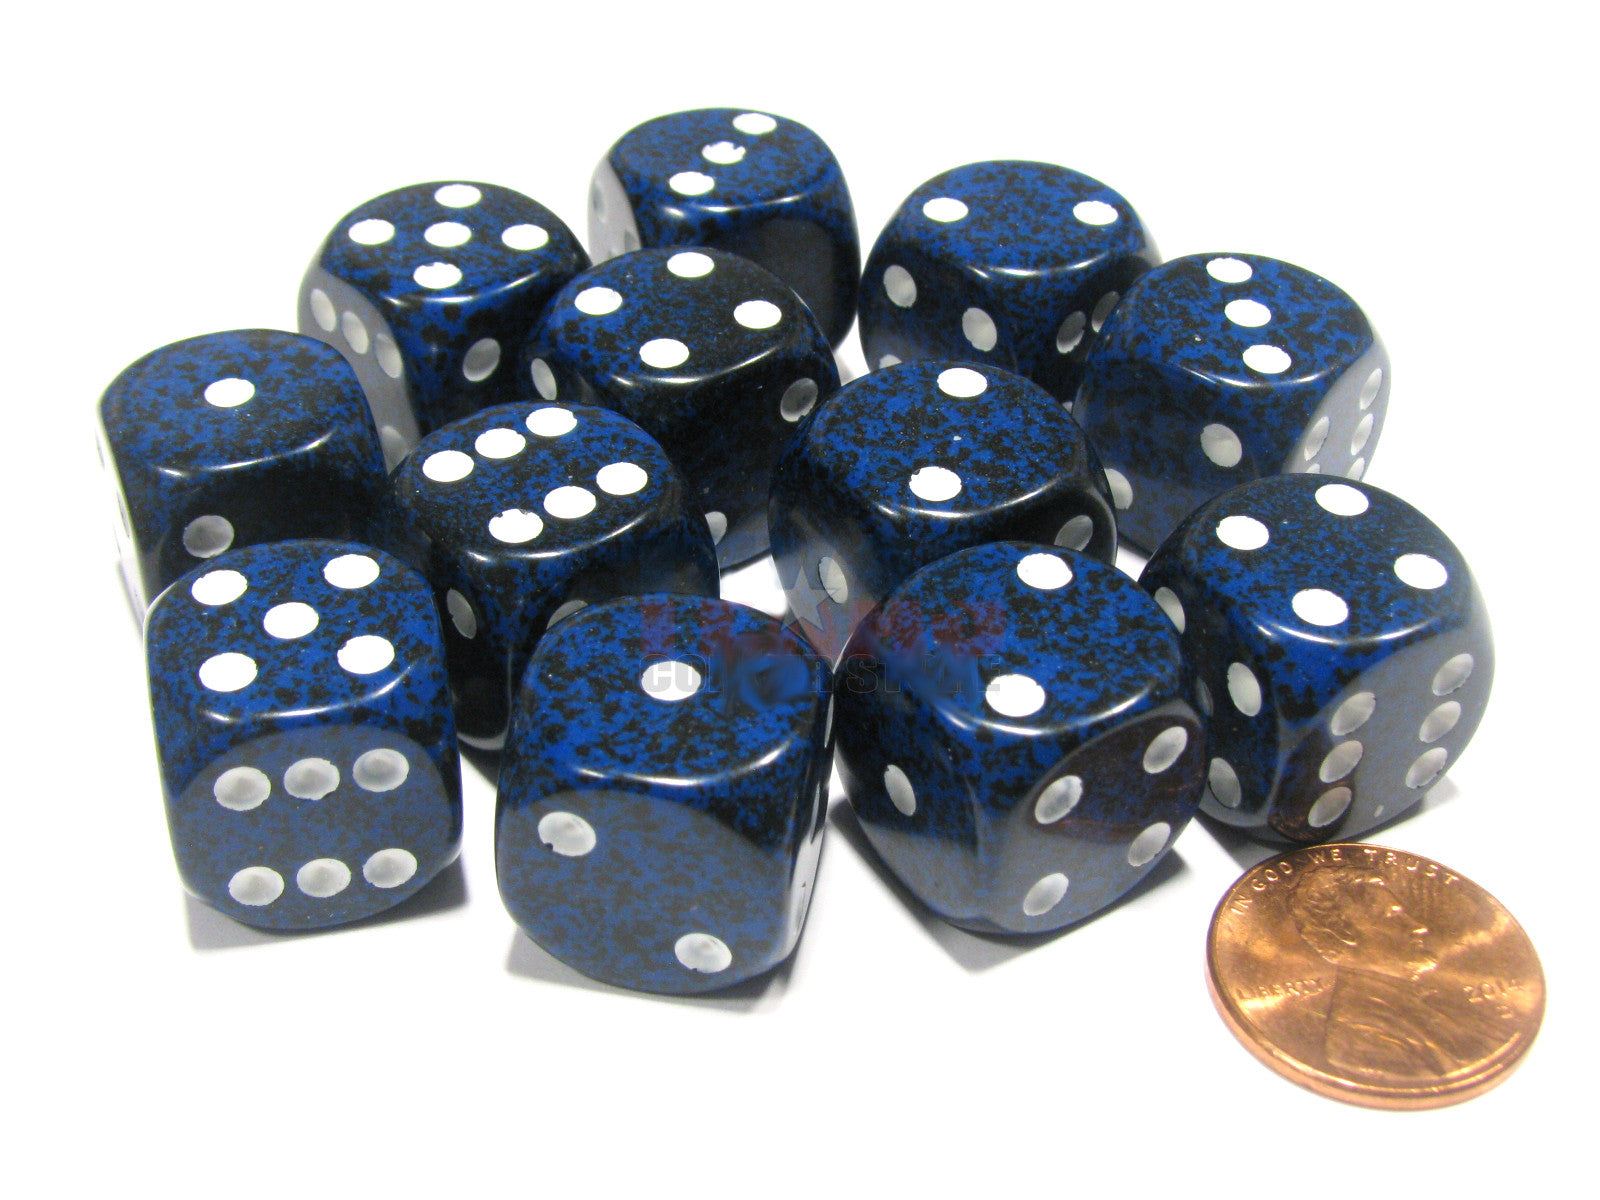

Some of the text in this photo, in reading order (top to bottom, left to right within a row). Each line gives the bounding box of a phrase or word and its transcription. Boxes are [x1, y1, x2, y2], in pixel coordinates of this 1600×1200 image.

[1230, 848, 1459, 915] IN GOD WE TRUST
[1237, 978, 1323, 1001] LIBERTY
[1462, 979, 1526, 1003] 2014
